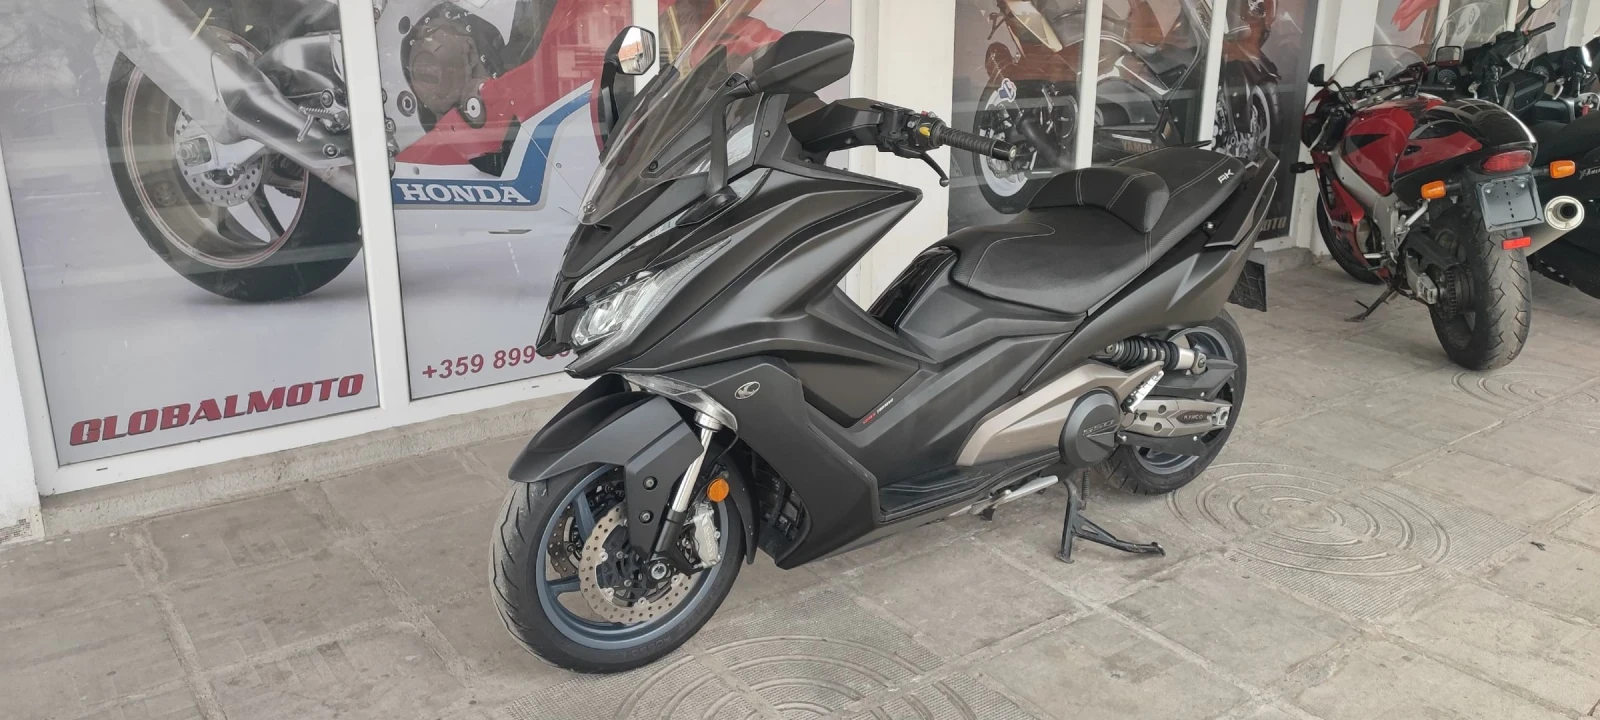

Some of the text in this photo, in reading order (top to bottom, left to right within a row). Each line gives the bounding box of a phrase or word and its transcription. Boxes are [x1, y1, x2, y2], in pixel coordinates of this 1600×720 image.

[1121, 140, 1159, 154] YAMAH
[1217, 168, 1235, 184] AK
[396, 183, 531, 203] HONDA
[422, 353, 484, 379] +359
[492, 345, 536, 369] 899
[69, 373, 364, 447] GLOBALMOTO
